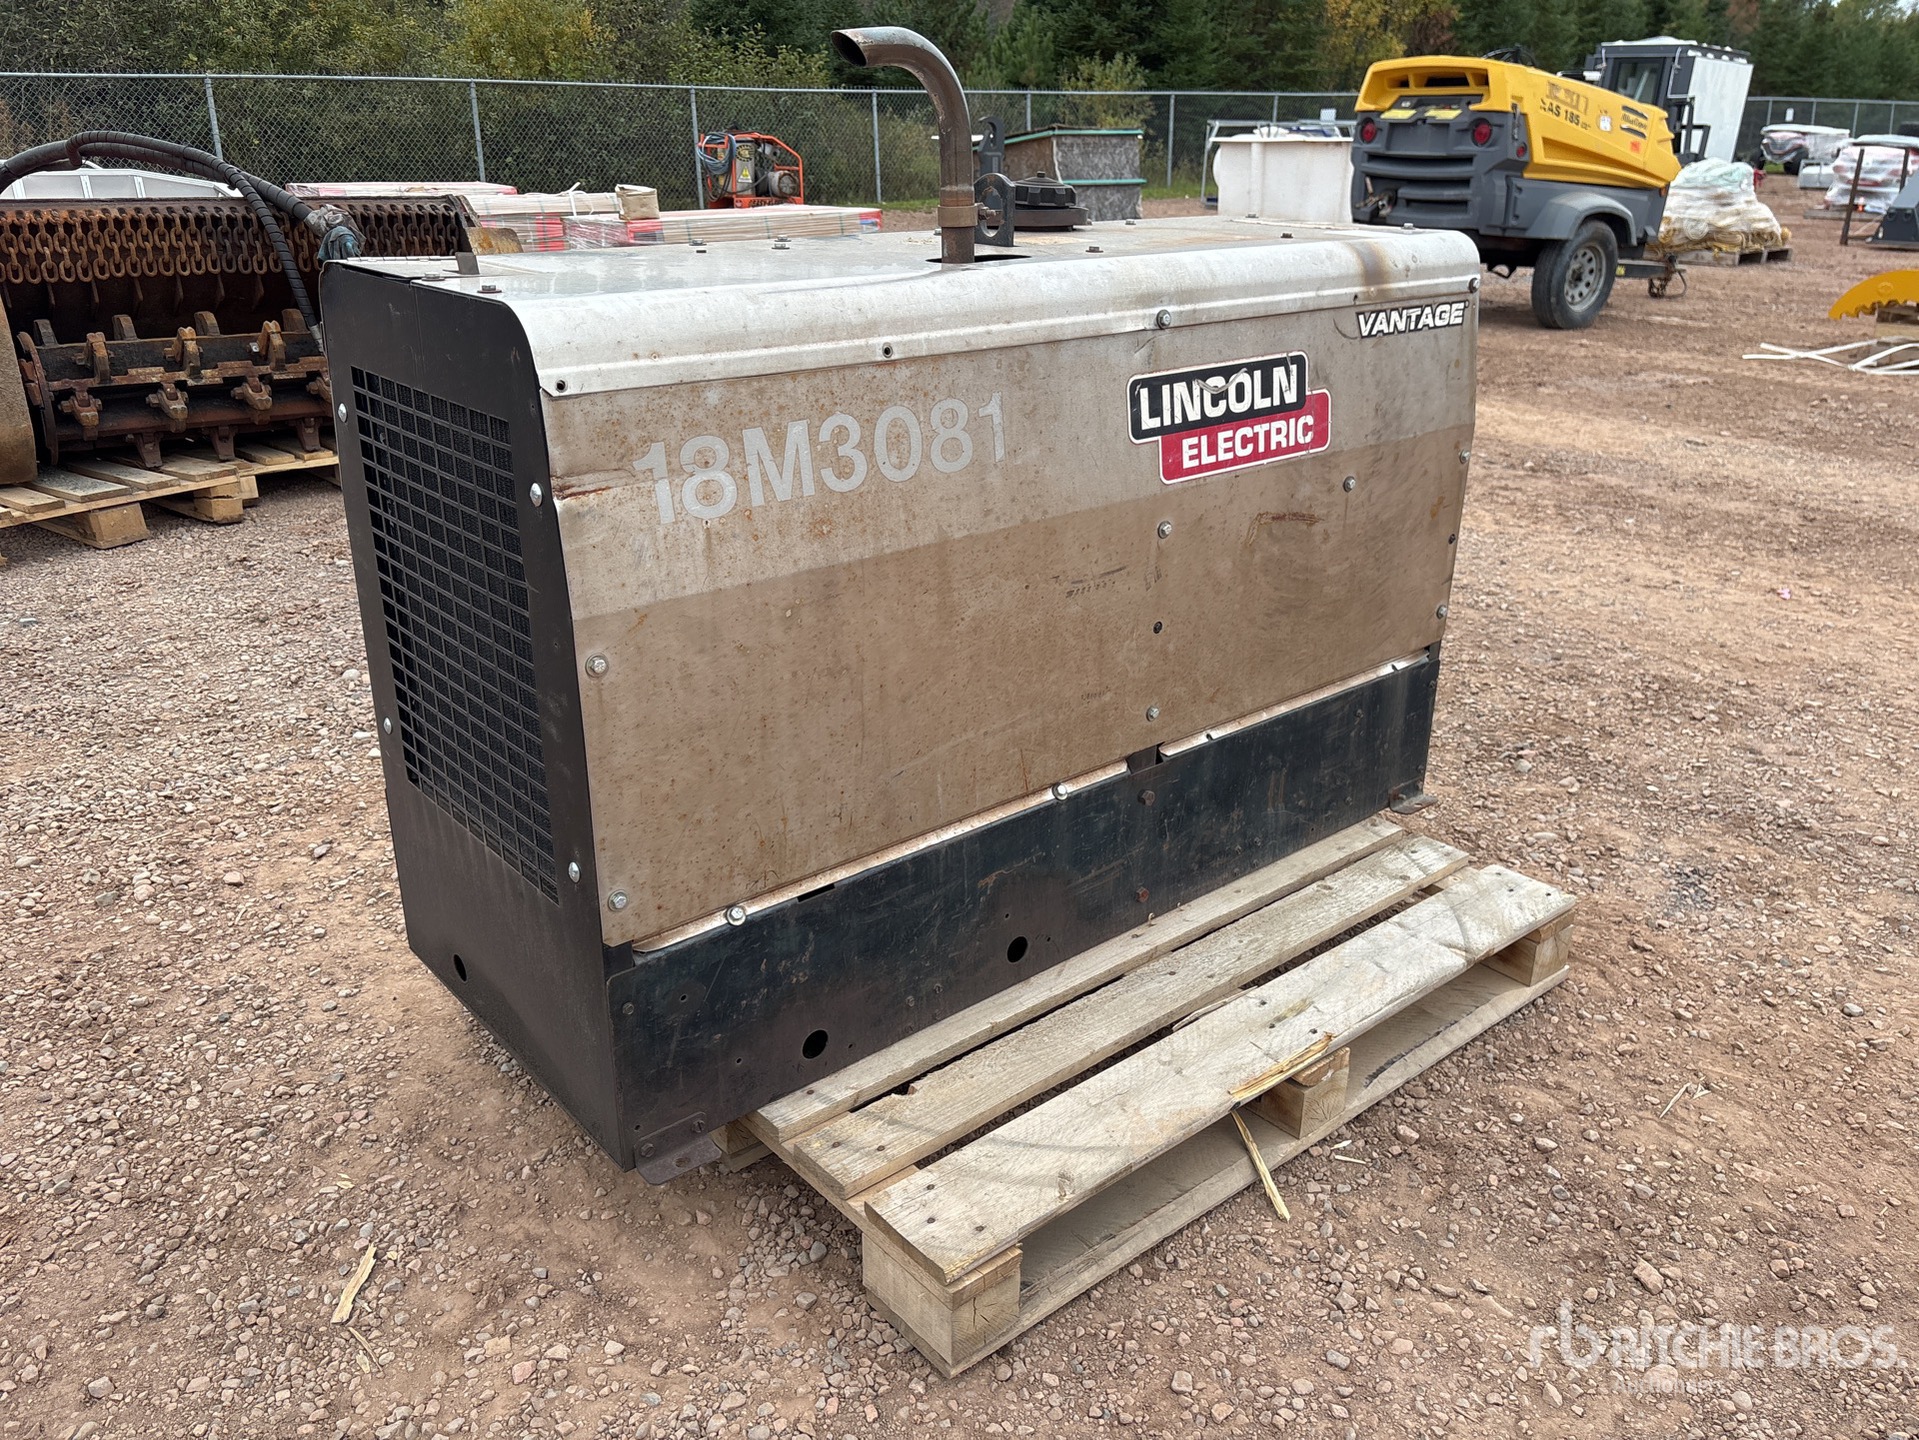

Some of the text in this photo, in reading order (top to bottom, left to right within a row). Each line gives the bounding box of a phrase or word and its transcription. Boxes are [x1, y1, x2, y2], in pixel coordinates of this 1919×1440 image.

[1564, 109, 1580, 127] 185
[1357, 301, 1465, 338] VANTAGE
[1139, 364, 1298, 431] LINCOLN
[632, 391, 1005, 524] 18M3081
[1181, 414, 1314, 469] ELECTRIC
